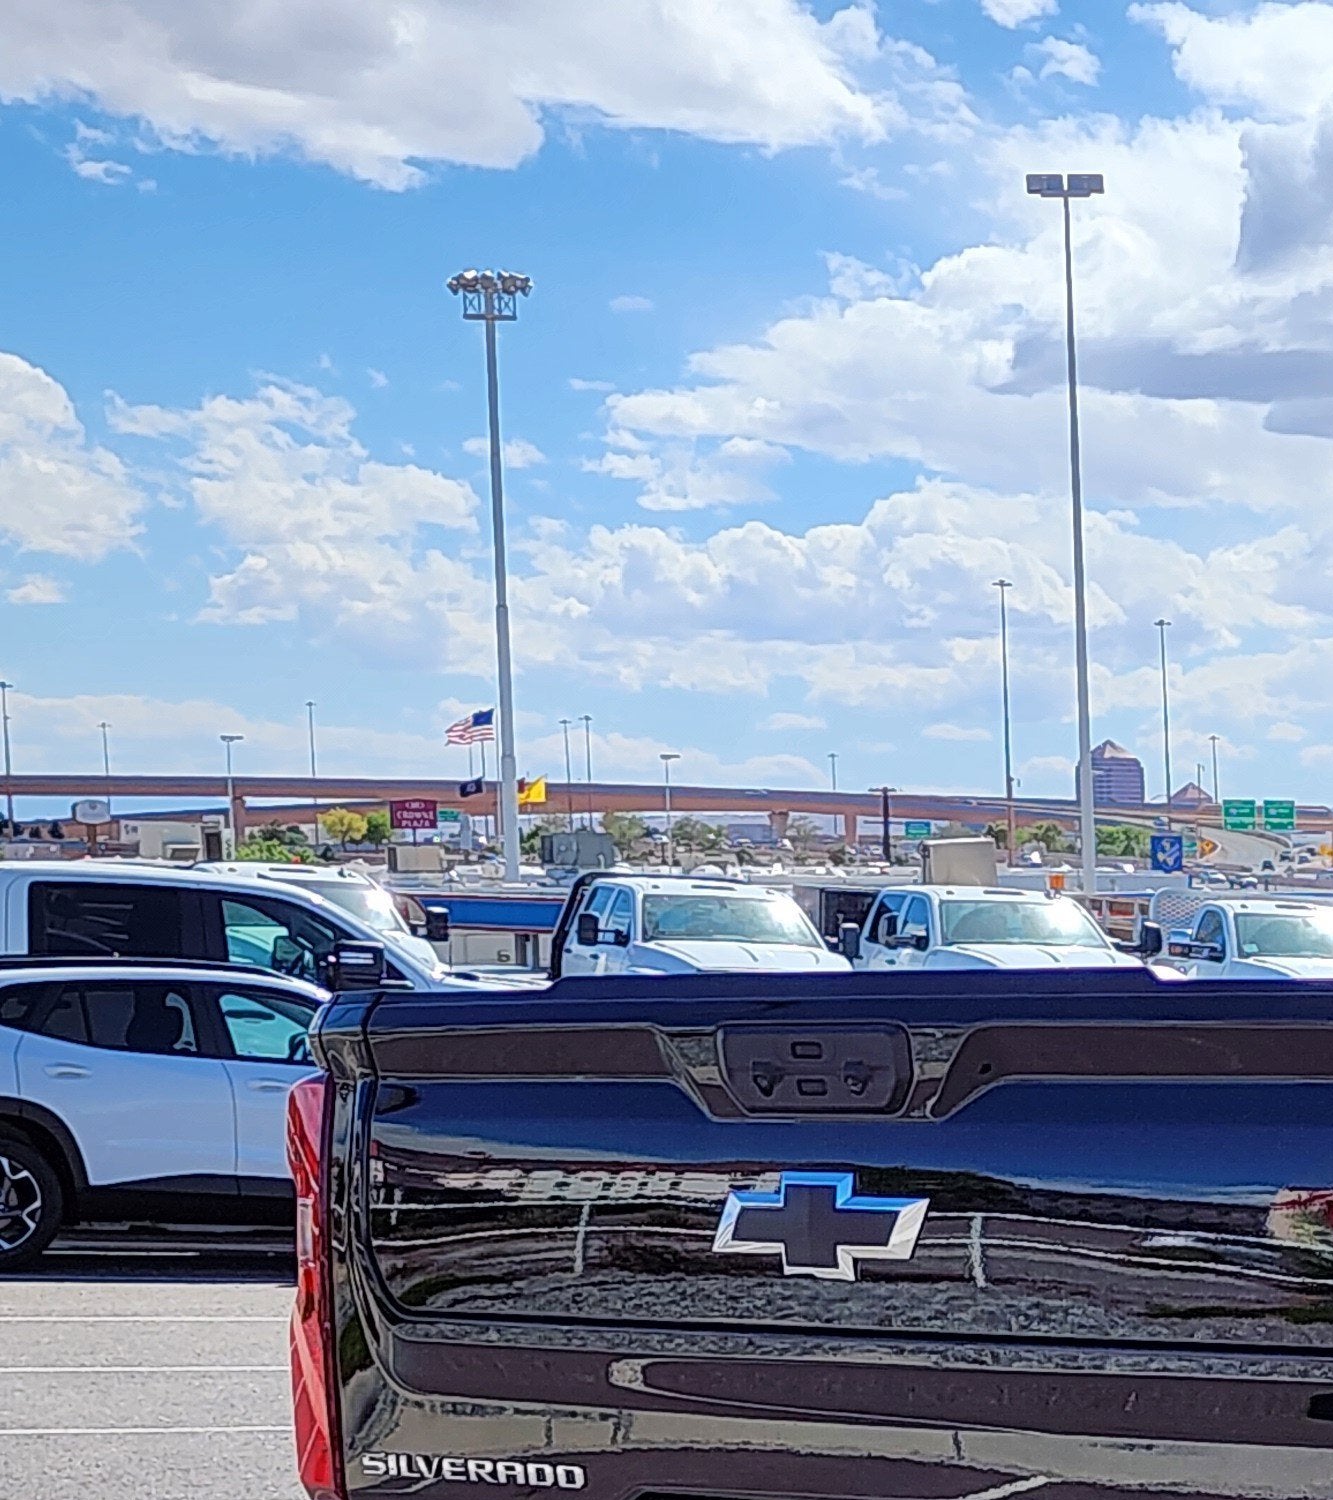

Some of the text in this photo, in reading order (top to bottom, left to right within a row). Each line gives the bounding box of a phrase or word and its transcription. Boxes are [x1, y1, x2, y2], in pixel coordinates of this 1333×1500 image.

[396, 810, 434, 820] CROWNE
[401, 820, 430, 828] PLAZA
[361, 1452, 587, 1490] SILVERADO
